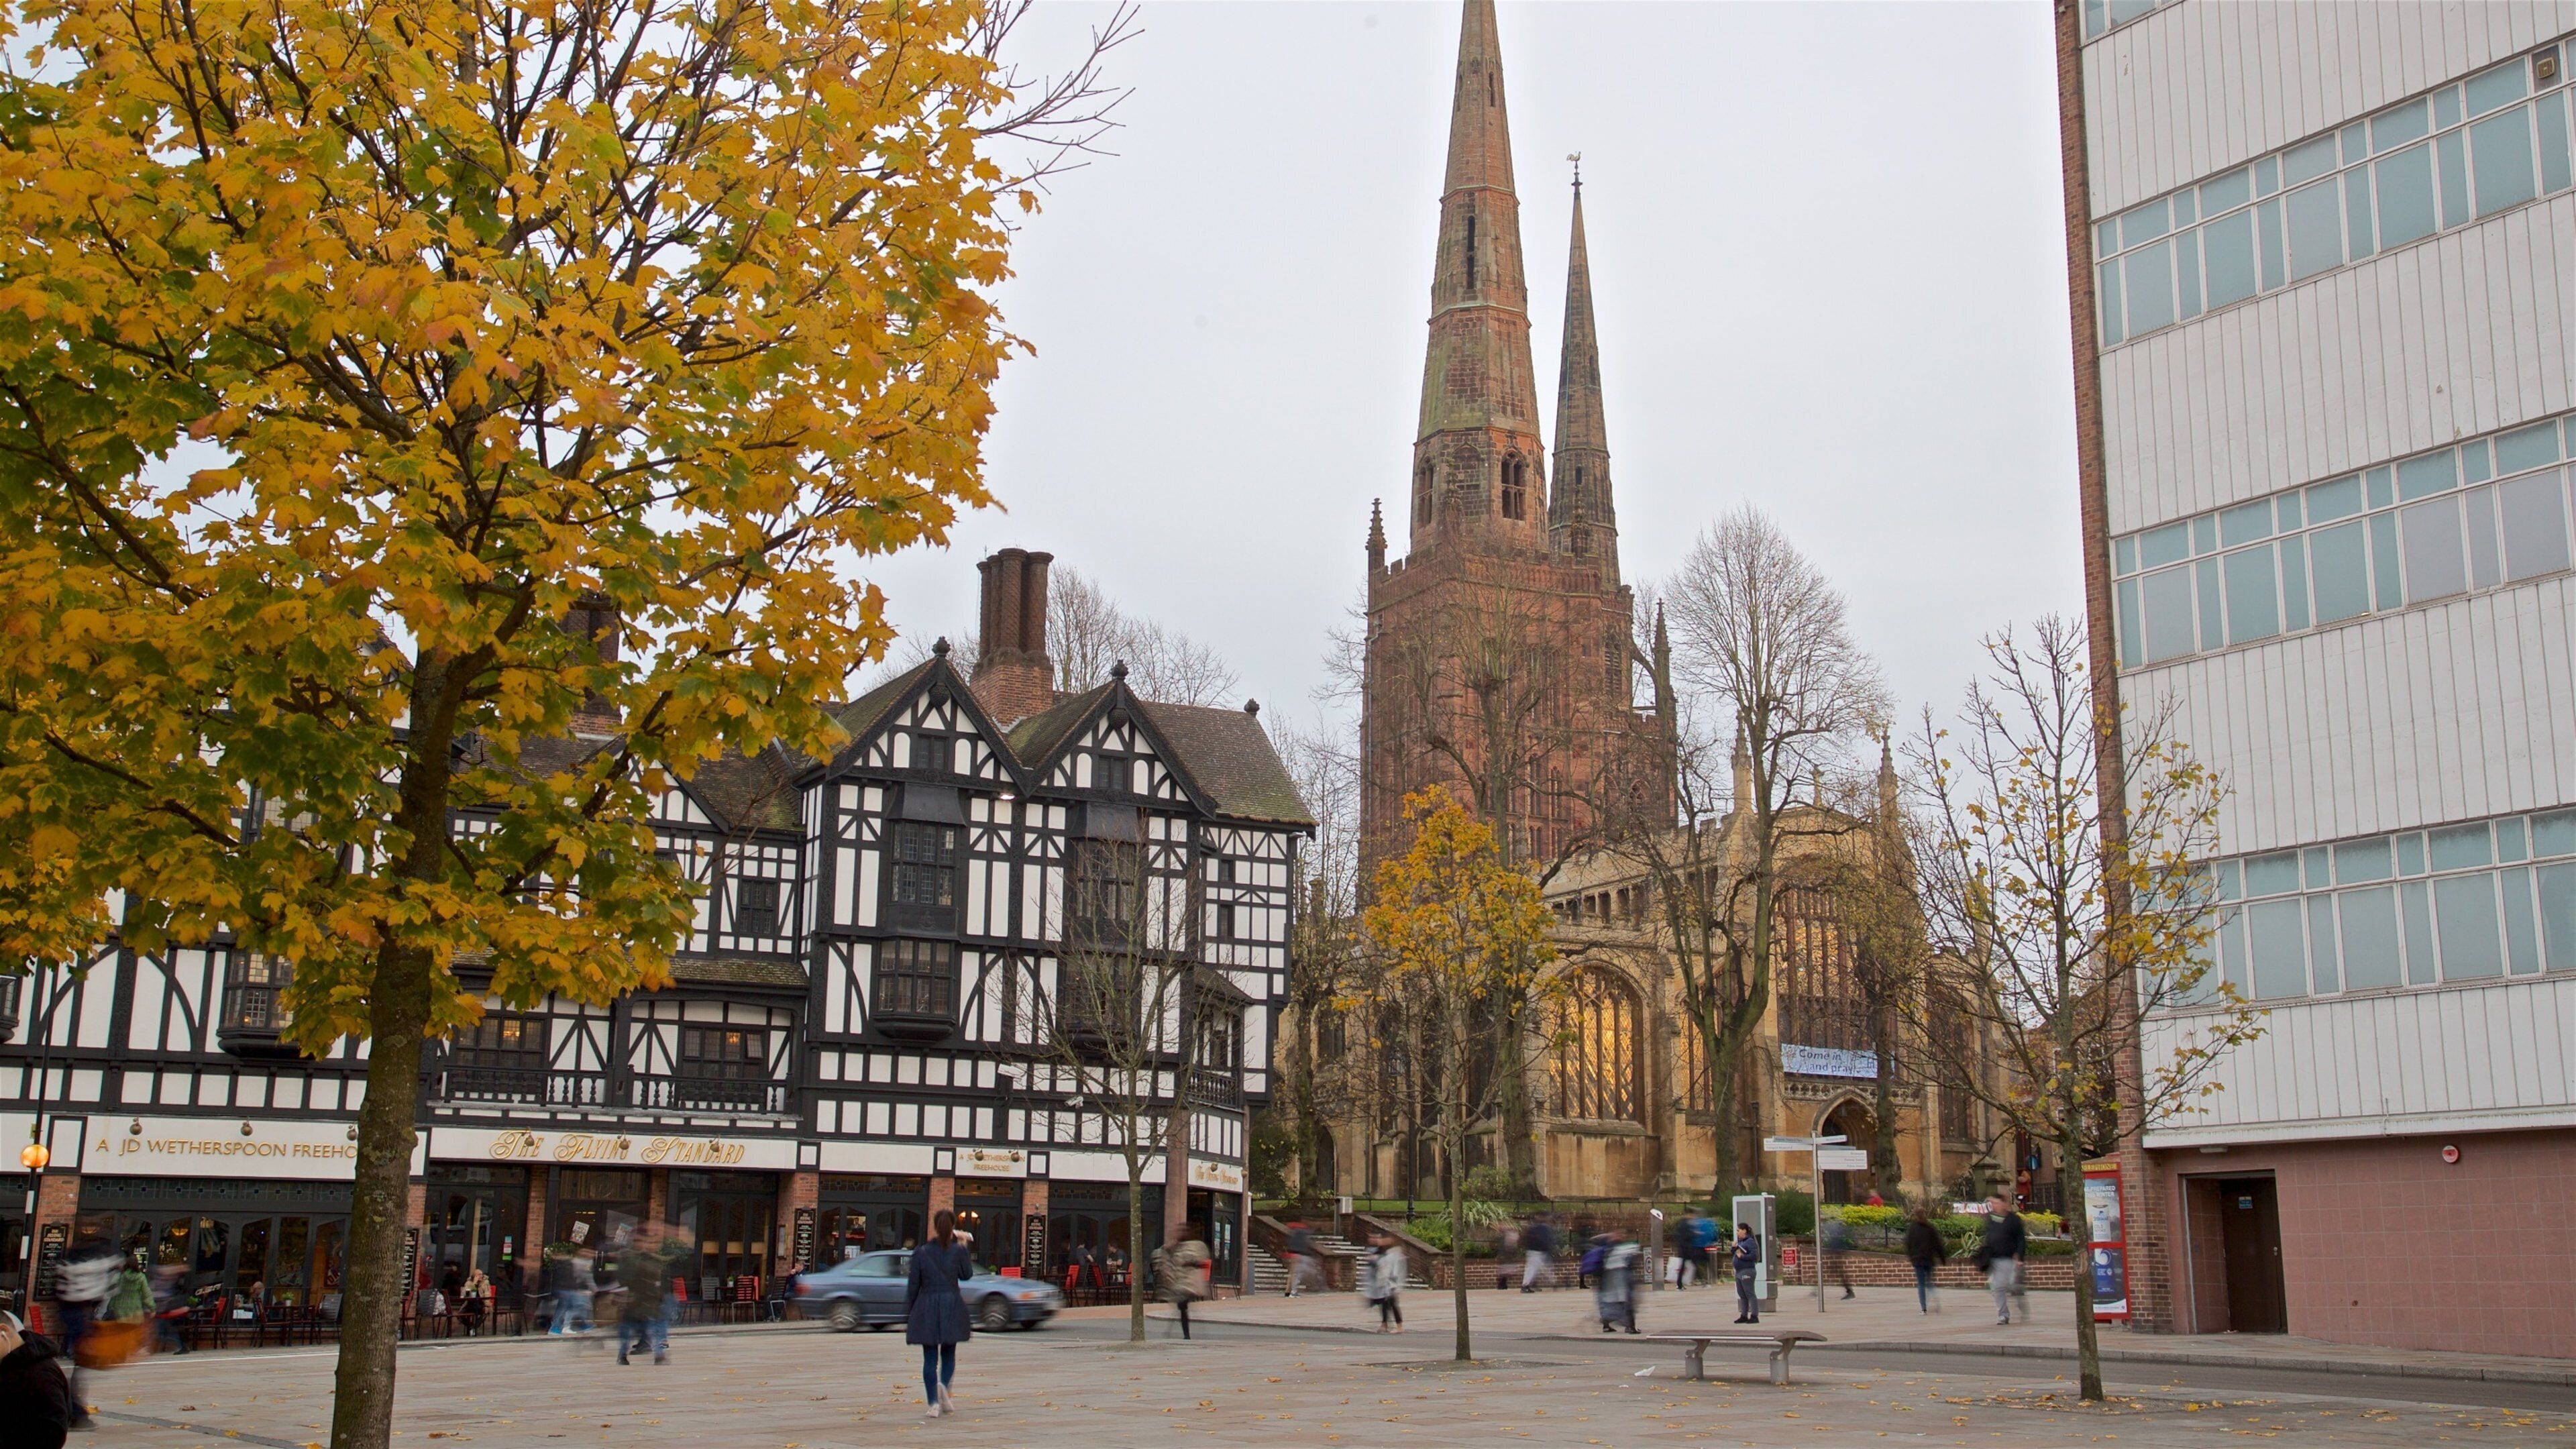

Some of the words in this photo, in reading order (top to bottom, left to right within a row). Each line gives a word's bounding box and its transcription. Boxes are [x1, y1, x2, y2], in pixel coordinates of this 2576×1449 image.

[1799, 1049, 1829, 1061] Come
[1832, 1053, 1841, 1061] in
[1810, 1063, 1828, 1071] and
[96, 1138, 109, 1152] A
[119, 1138, 141, 1156] JD
[148, 1139, 286, 1157] WETHERSPOON
[292, 1143, 358, 1159] FREEHO
